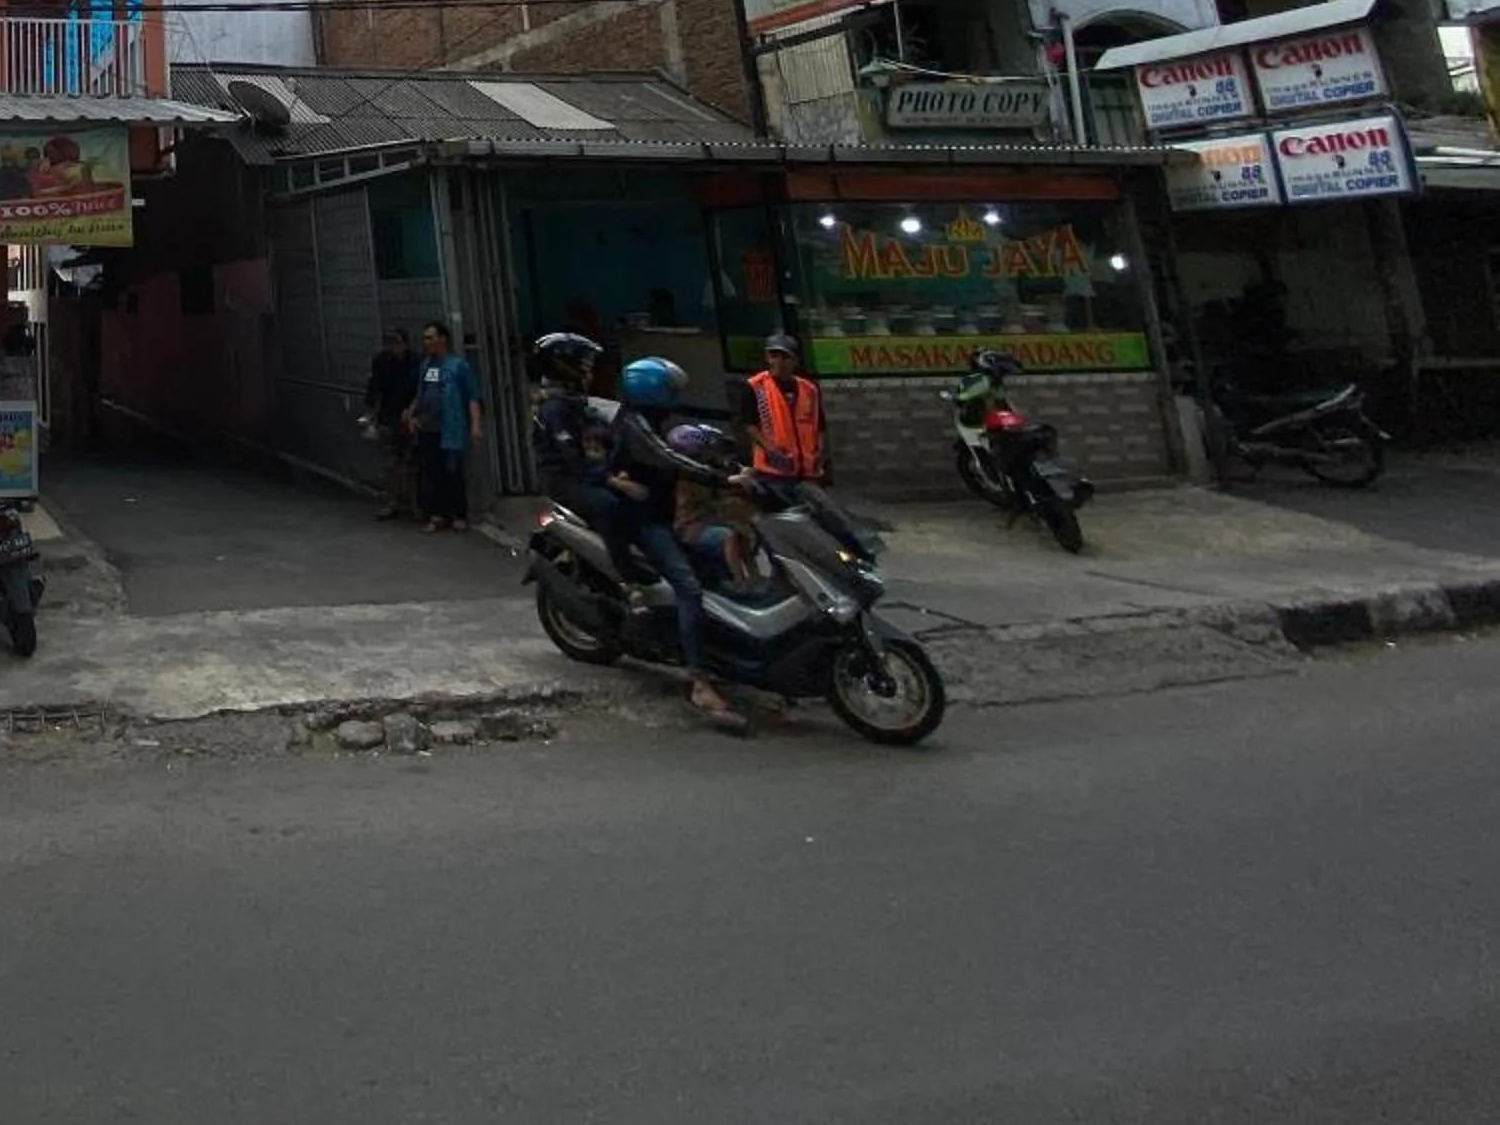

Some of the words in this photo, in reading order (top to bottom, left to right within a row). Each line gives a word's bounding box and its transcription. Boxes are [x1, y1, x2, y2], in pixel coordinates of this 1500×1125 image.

[1257, 33, 1363, 69] Canon
[1139, 55, 1233, 88] Canon
[898, 91, 976, 113] PHOTO
[983, 90, 1043, 113] COPY
[1269, 89, 1320, 107] DIGITAL
[1323, 80, 1375, 98] COPIER
[1151, 105, 1195, 124] DIGITAL
[1197, 101, 1242, 116] COPIER
[1279, 128, 1389, 157] Canon
[1221, 187, 1268, 203] COPIER
[1291, 179, 1342, 196] DIGITAL
[1346, 175, 1399, 191] COPIER
[0, 201, 72, 217] 100%
[840, 222, 970, 279] MAJU
[980, 222, 1092, 277] JAYA
[850, 341, 981, 368] MASAKA
